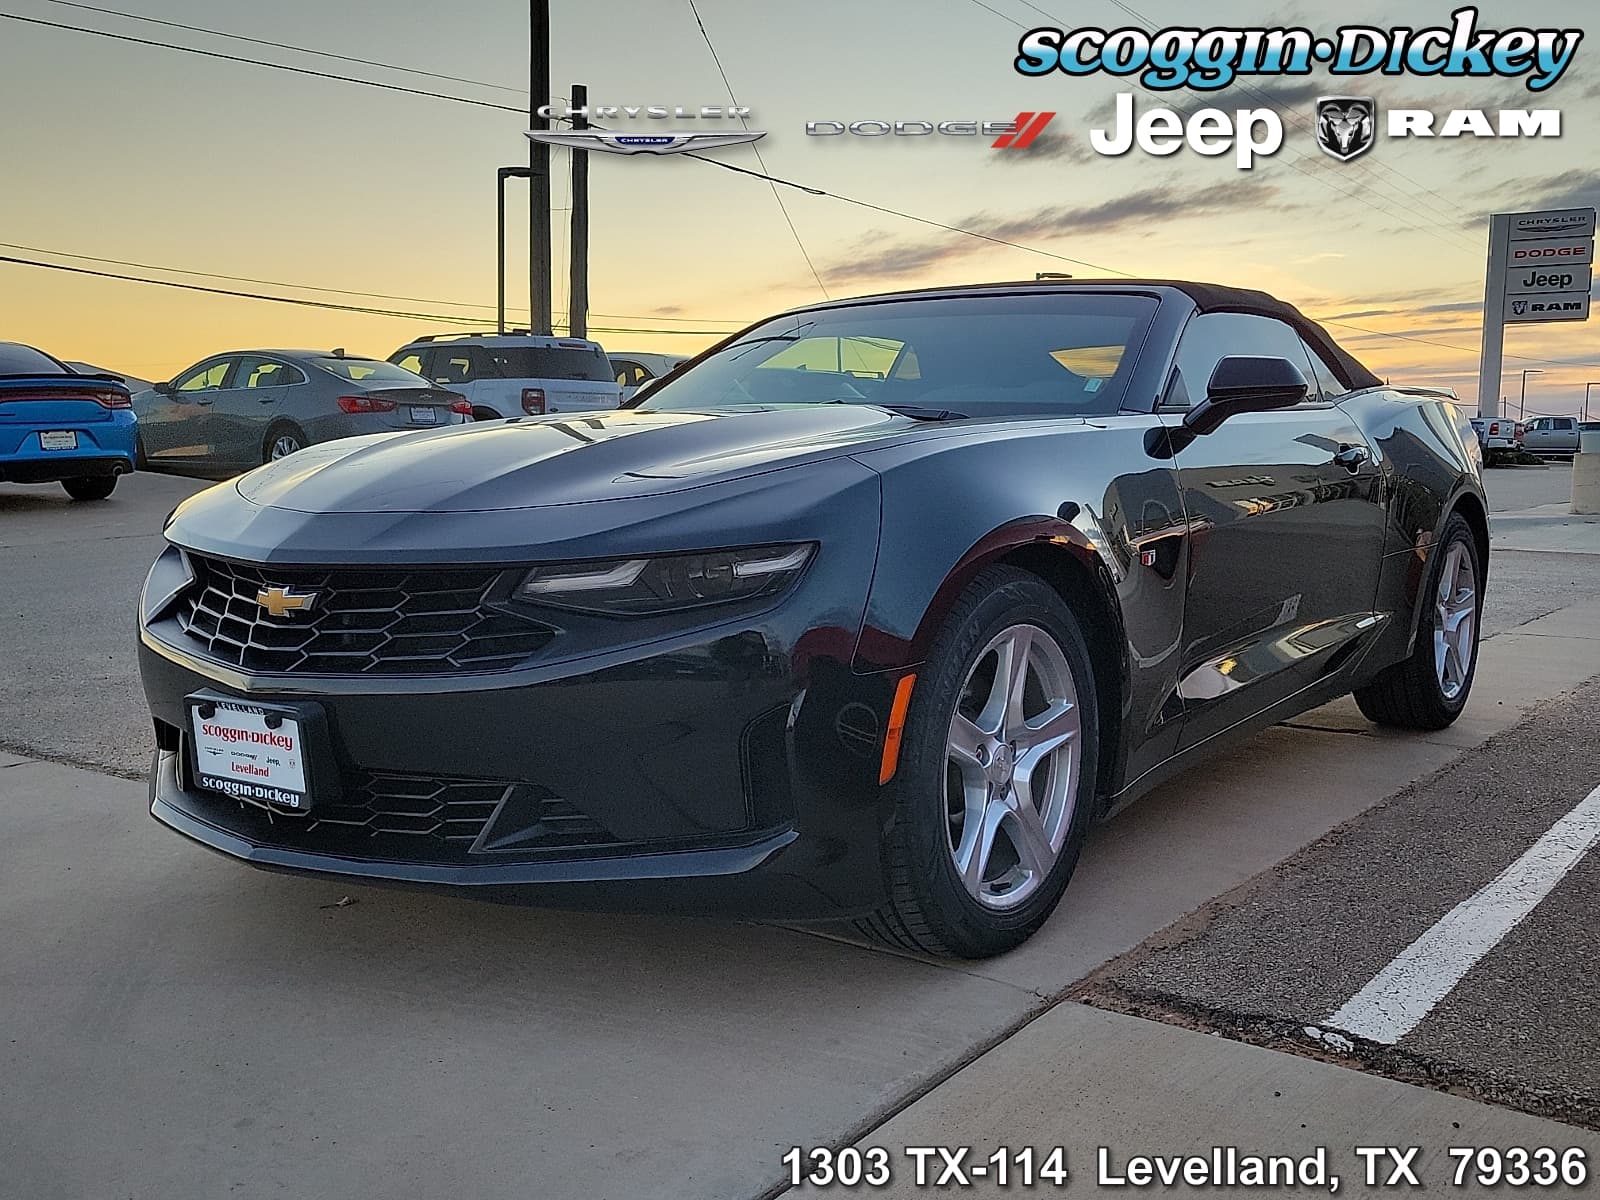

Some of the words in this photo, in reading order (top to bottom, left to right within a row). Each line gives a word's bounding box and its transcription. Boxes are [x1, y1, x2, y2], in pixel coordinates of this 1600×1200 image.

[1518, 216, 1587, 227] CHRYSLER
[1514, 246, 1586, 259] DODGE
[1523, 271, 1573, 289] Jeep
[1531, 301, 1582, 312] RAM
[231, 761, 269, 777] Levelland
